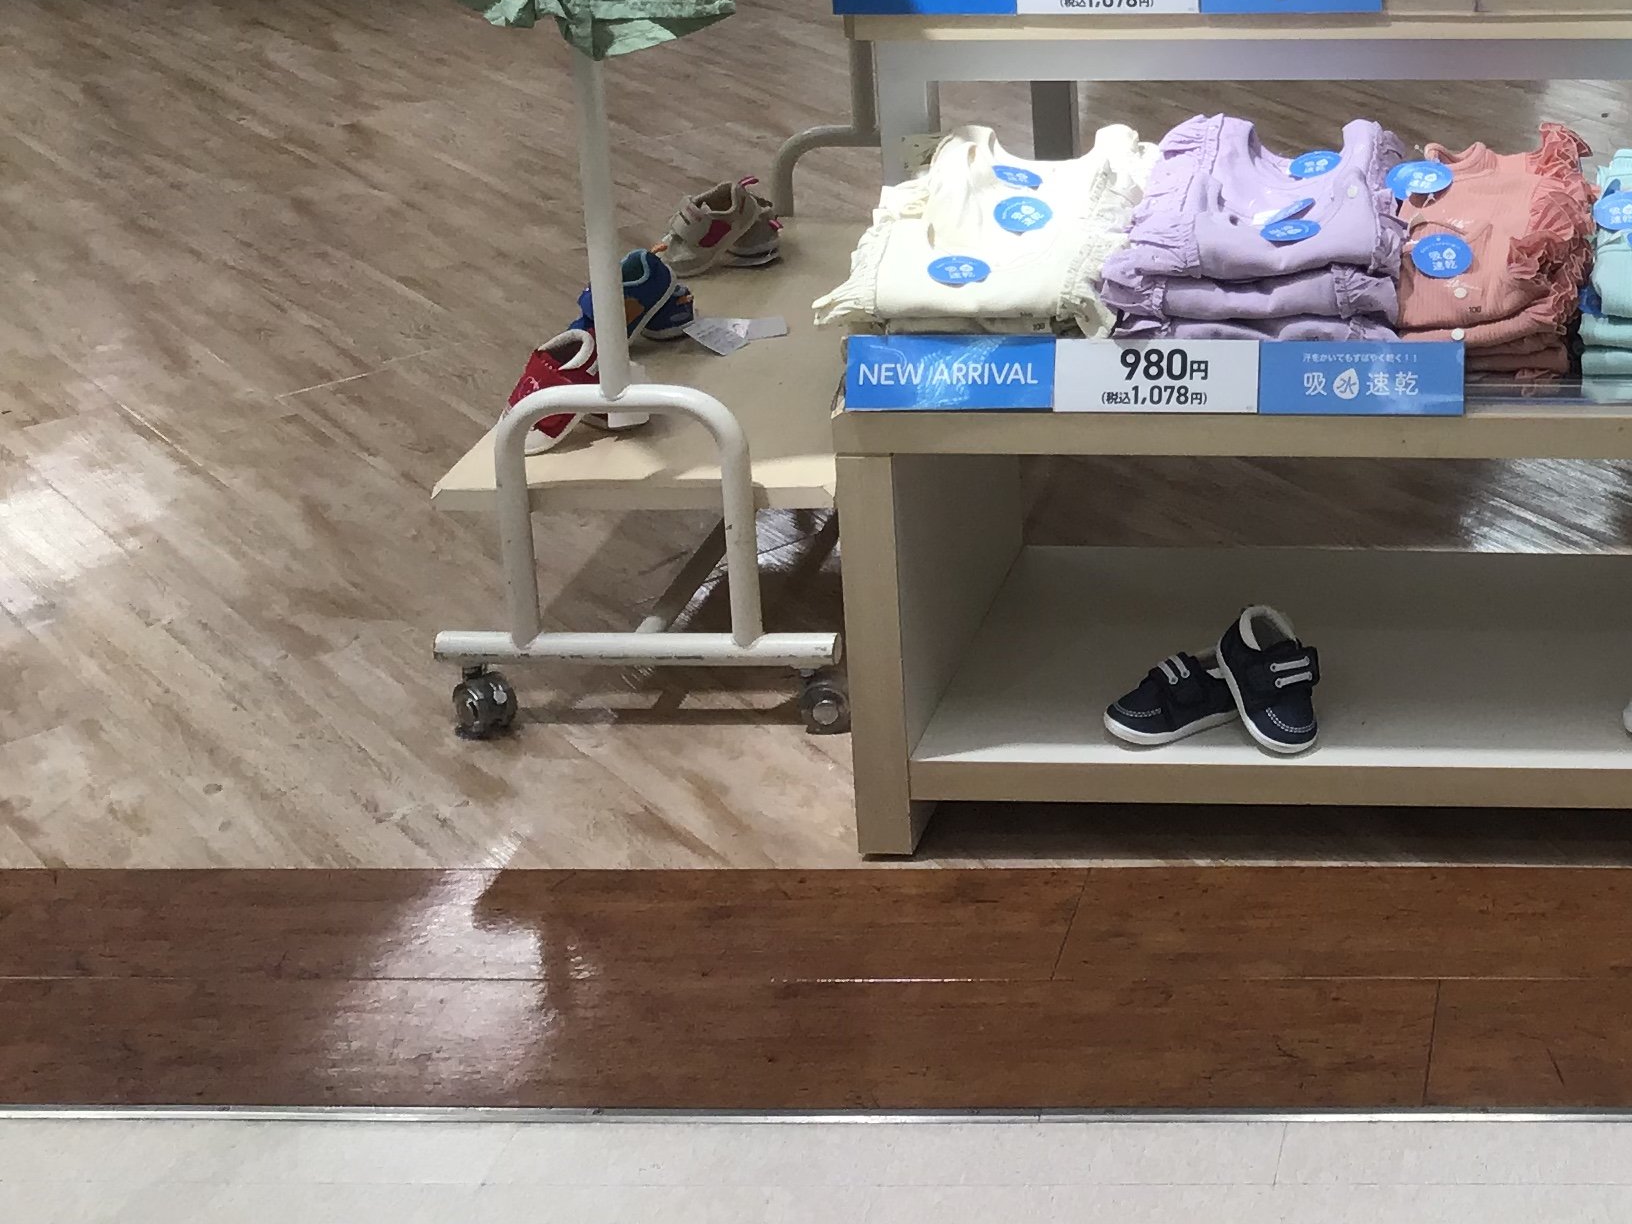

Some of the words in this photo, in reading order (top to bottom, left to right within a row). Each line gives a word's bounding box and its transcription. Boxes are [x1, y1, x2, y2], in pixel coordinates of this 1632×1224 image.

[1468, 305, 1482, 313] 100
[858, 363, 923, 386] NEW
[933, 362, 1039, 386] ARRIVAL
[1119, 348, 1209, 381] 980円
[1101, 385, 1207, 406] (税込1,078円)
[1303, 368, 1419, 400] 吸水速乾
